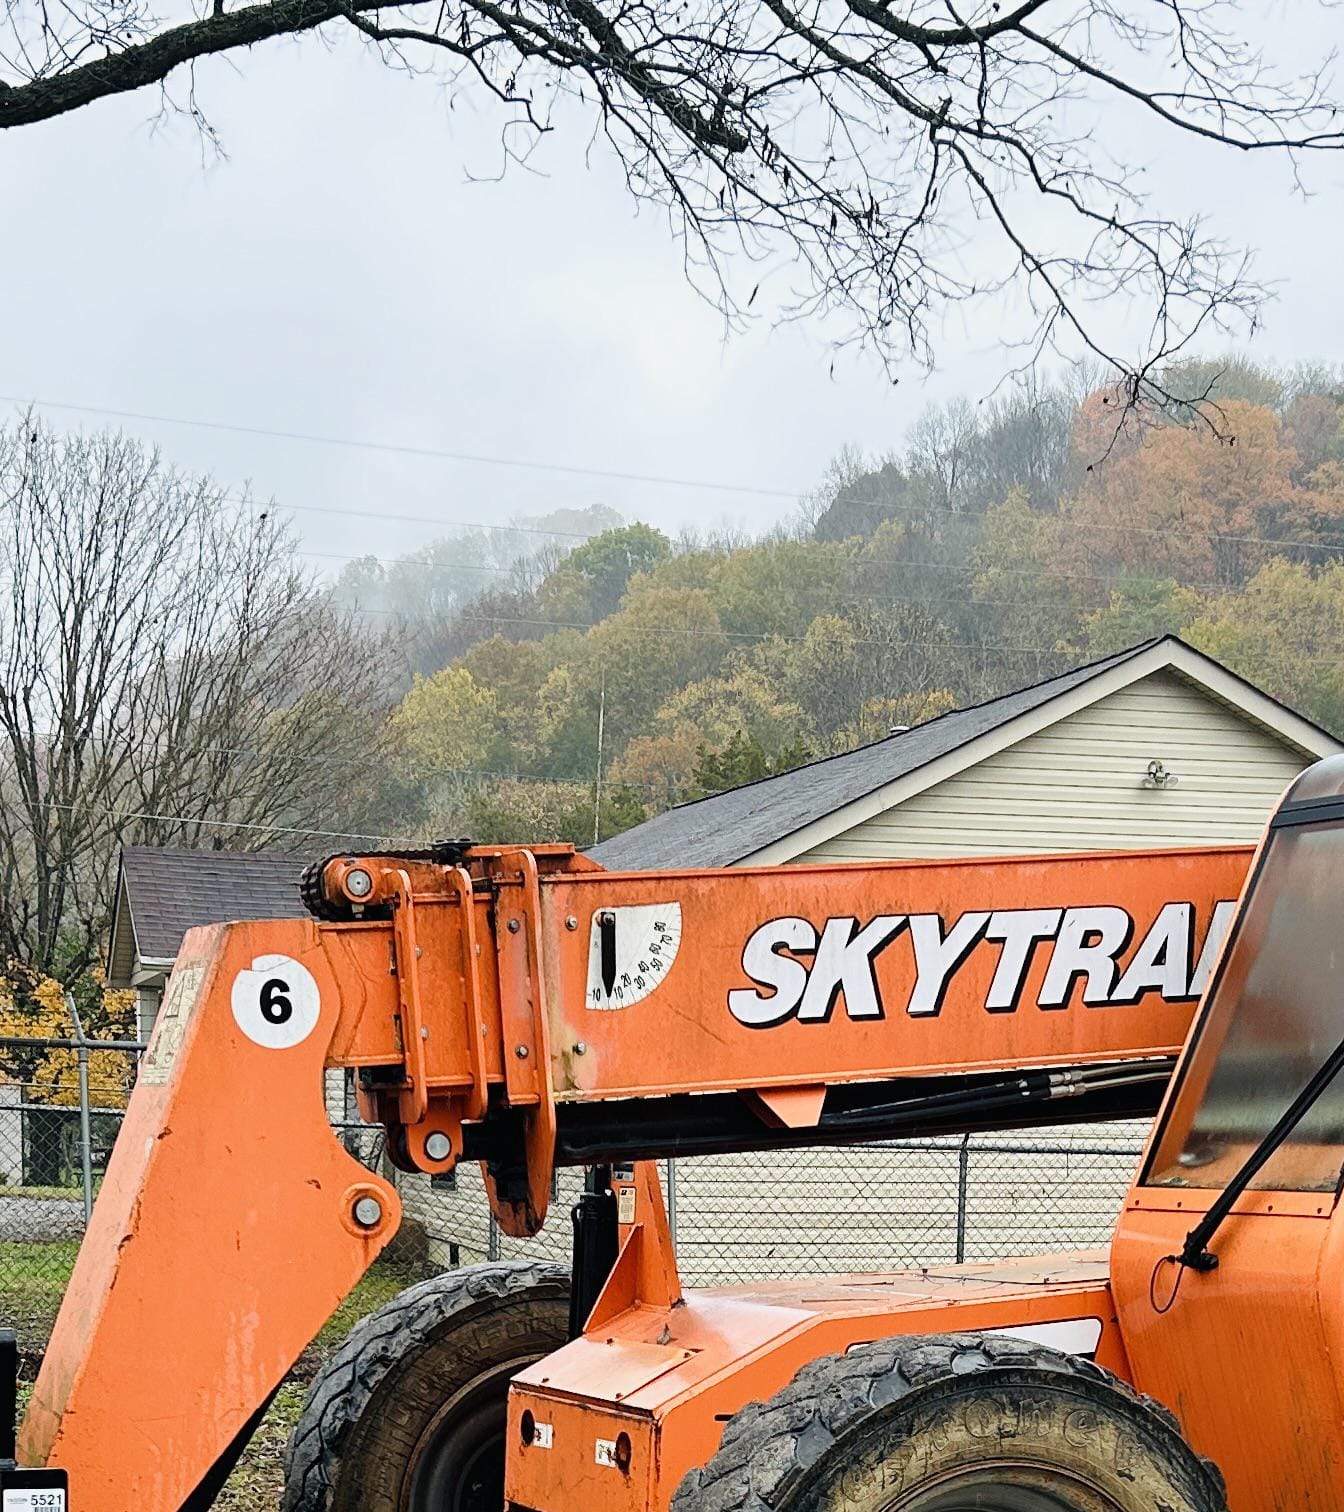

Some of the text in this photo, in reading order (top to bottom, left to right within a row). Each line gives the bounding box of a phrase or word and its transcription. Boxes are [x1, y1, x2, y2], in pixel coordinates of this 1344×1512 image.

[621, 973, 632, 988] 20
[634, 975, 646, 990] 30
[592, 988, 601, 1001] 10
[614, 986, 624, 999] 10
[260, 978, 293, 1025] 6
[31, 1494, 62, 1506] 5521
